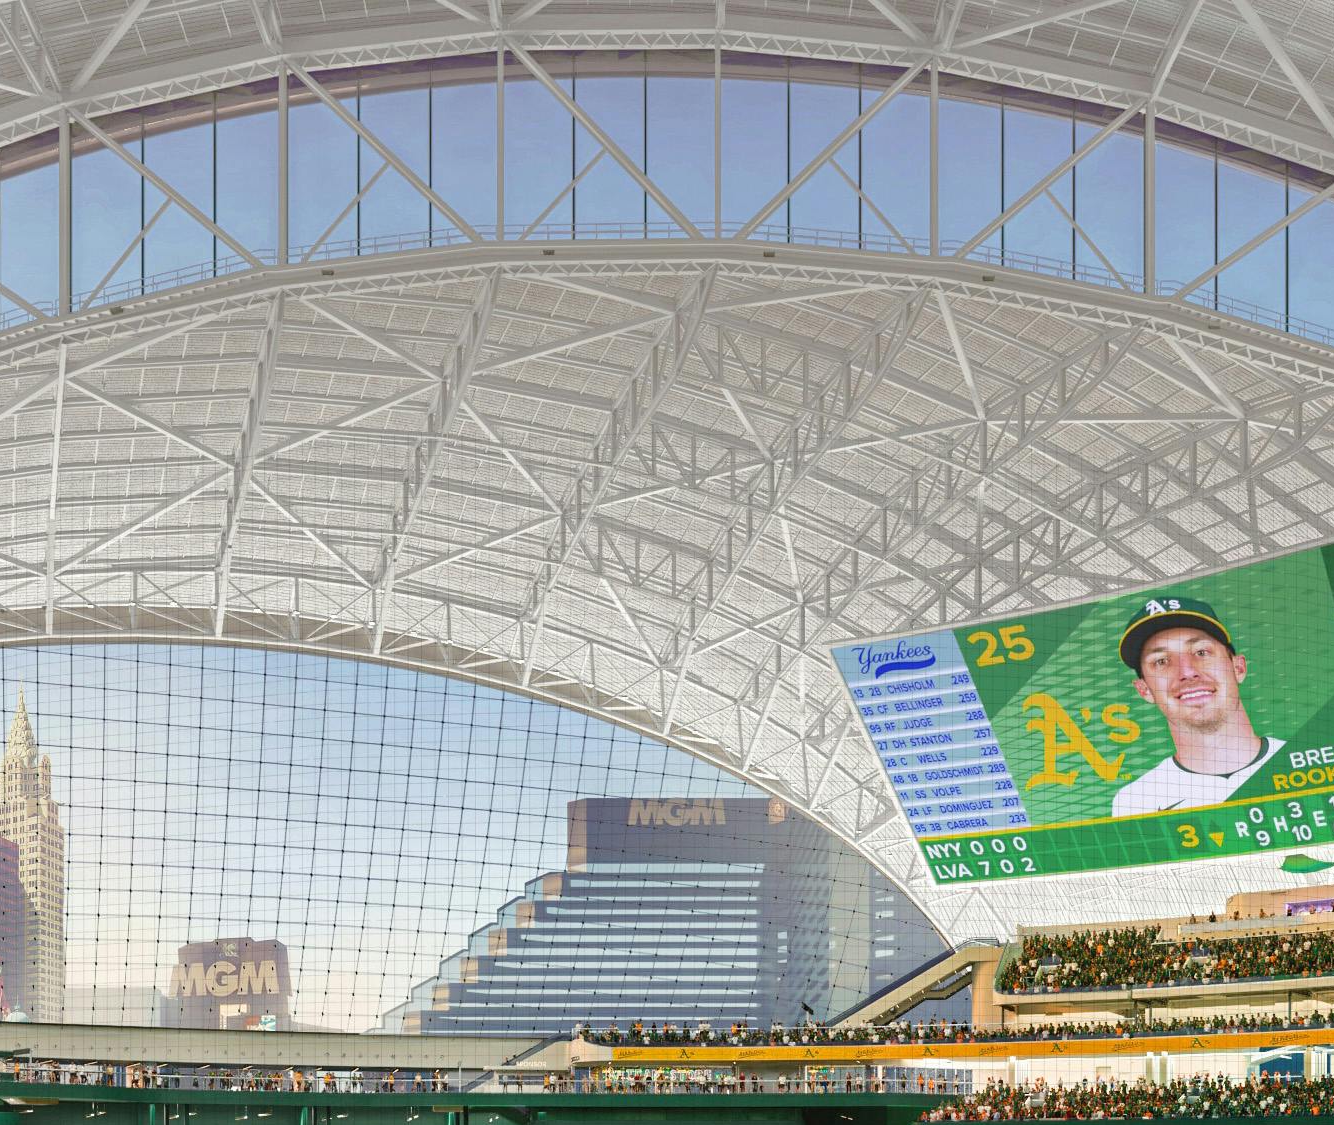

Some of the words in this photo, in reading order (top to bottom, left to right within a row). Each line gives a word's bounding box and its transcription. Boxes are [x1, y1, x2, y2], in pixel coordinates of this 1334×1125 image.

[1145, 599, 1180, 616] A's
[967, 624, 1034, 666] 25
[852, 641, 936, 678] Yankees
[852, 688, 865, 699] 13
[867, 685, 883, 697] 2B
[885, 678, 936, 695] CHISHOLM
[860, 705, 874, 717] 35
[876, 703, 889, 715] CF
[893, 696, 944, 713] BELLINGER
[868, 723, 882, 734] 99
[883, 721, 896, 731] RF
[902, 716, 934, 730] JUDGE
[876, 740, 888, 751] 27
[891, 738, 907, 749] DH
[908, 732, 953, 747] STANTON
[1024, 692, 1141, 790] A's
[883, 757, 898, 768] 28
[899, 756, 908, 766] C
[915, 751, 948, 764] WELLS
[892, 774, 905, 784] 48
[906, 772, 919, 783] 1B
[923, 764, 984, 781] GOLDSCHMIDT
[899, 791, 909, 799] 11
[913, 789, 927, 799] SS
[930, 785, 963, 797] VOLPE
[628, 798, 726, 826] MGM
[906, 806, 920, 817] 24
[920, 805, 933, 816] LF
[938, 799, 994, 814] DOMINGUEZ
[1249, 807, 1263, 823] 0
[1287, 801, 1302, 818] 3
[913, 822, 927, 833] 95
[928, 821, 942, 832] 3B
[945, 817, 989, 830] CABRERA
[1273, 815, 1288, 832] H
[1312, 810, 1326, 826] E
[1177, 824, 1199, 847] 3
[1235, 821, 1249, 837] R
[1256, 830, 1270, 846] 9
[1291, 824, 1312, 841] 10
[925, 842, 961, 859] NYY
[970, 840, 984, 855] 0
[991, 838, 1005, 853] 0
[1012, 836, 1026, 851] 0
[934, 863, 973, 878] LVA
[977, 861, 989, 875] 7
[1000, 859, 1014, 873] 0
[1021, 857, 1036, 871] 2
[167, 960, 280, 999] MGM
